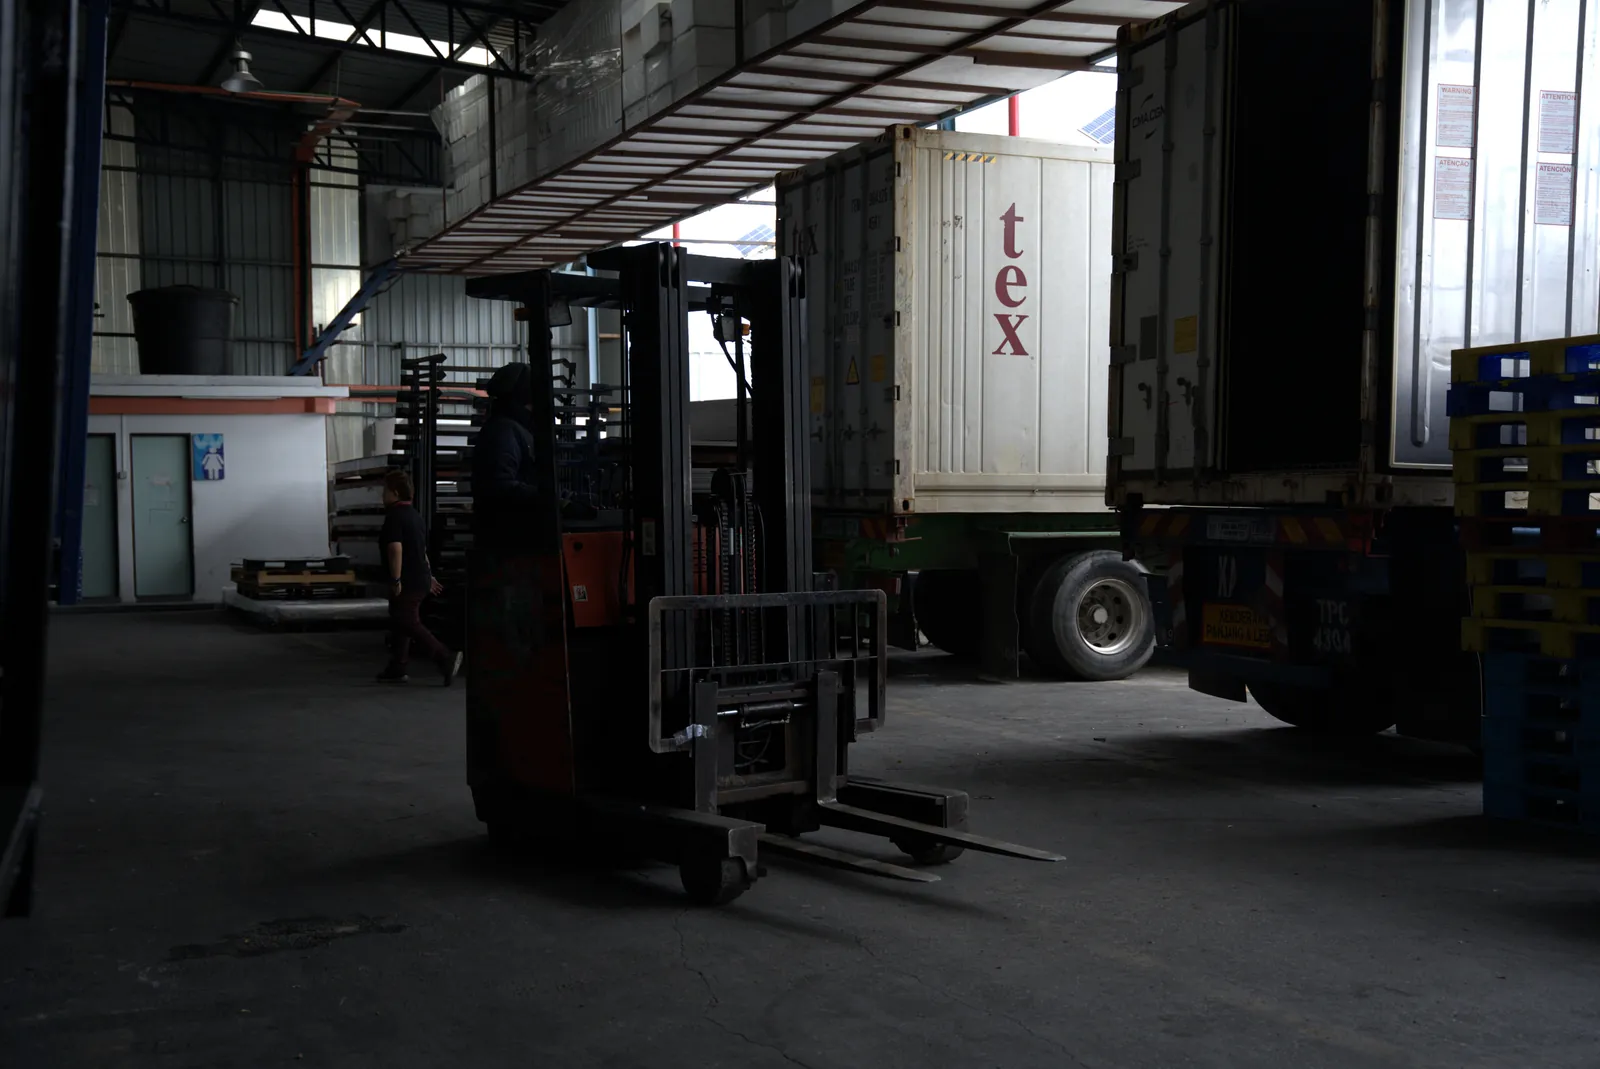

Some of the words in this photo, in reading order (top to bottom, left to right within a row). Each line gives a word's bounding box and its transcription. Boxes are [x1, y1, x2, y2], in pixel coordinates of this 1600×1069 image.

[1441, 87, 1472, 95] WARNING
[1541, 93, 1577, 101] ATTENTION
[992, 202, 1030, 356] tex
